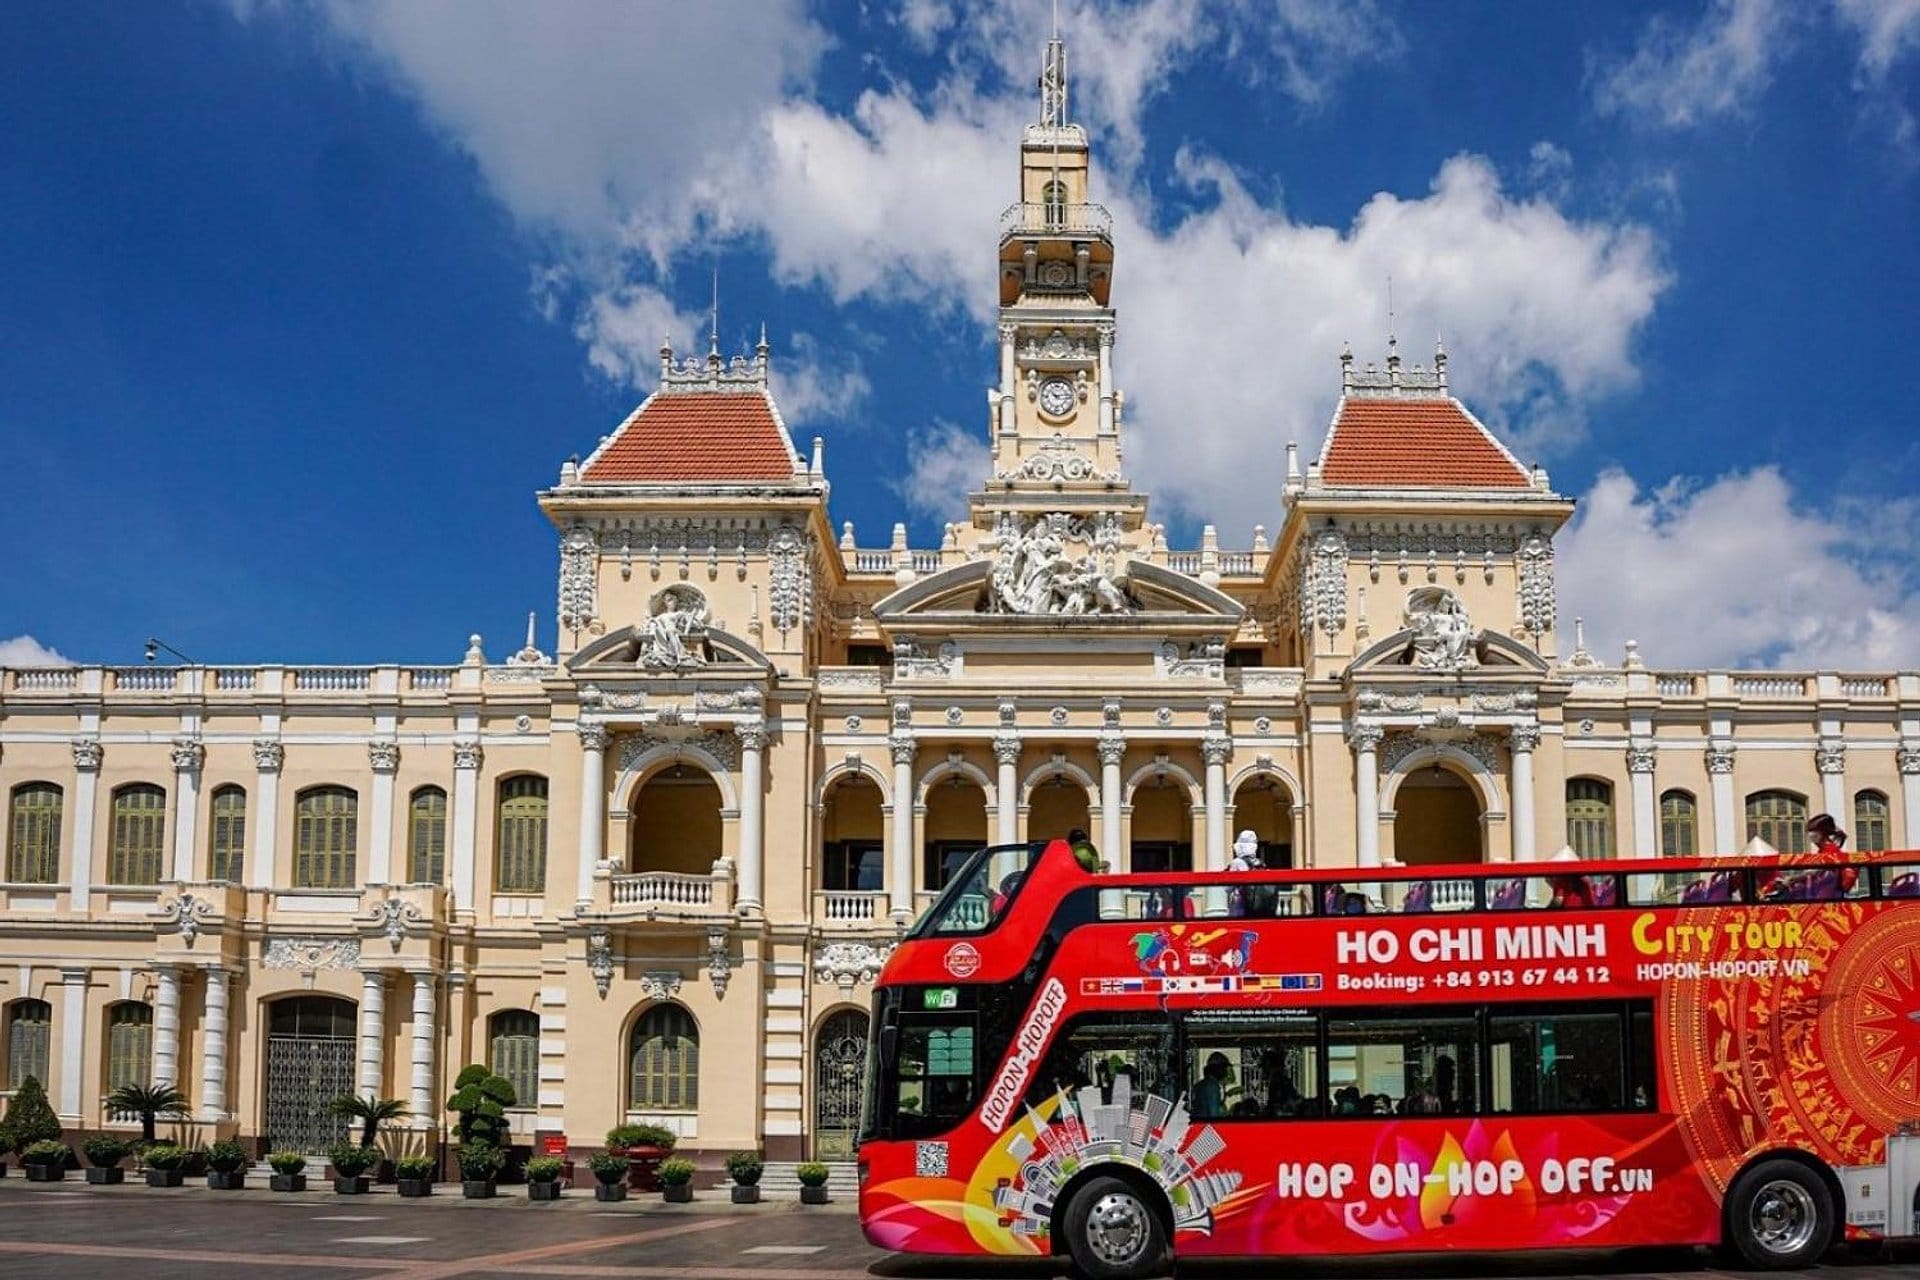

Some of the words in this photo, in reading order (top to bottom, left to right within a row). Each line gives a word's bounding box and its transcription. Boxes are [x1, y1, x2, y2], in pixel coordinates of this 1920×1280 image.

[1336, 930, 1399, 964] HO
[1408, 927, 1483, 963] CHI
[1494, 923, 1608, 960] MINH
[1632, 912, 1715, 955] CITY
[1724, 921, 1804, 950] TOUR
[1336, 971, 1425, 994] Booking:
[1432, 970, 1472, 988] +84
[1477, 969, 1515, 987] 913
[1521, 968, 1547, 986] 67
[1552, 967, 1578, 985] 44
[1586, 966, 1610, 984] 12
[1636, 959, 1810, 982] HOPON-HOPOFF.VN
[1277, 1162, 1354, 1200] HOP
